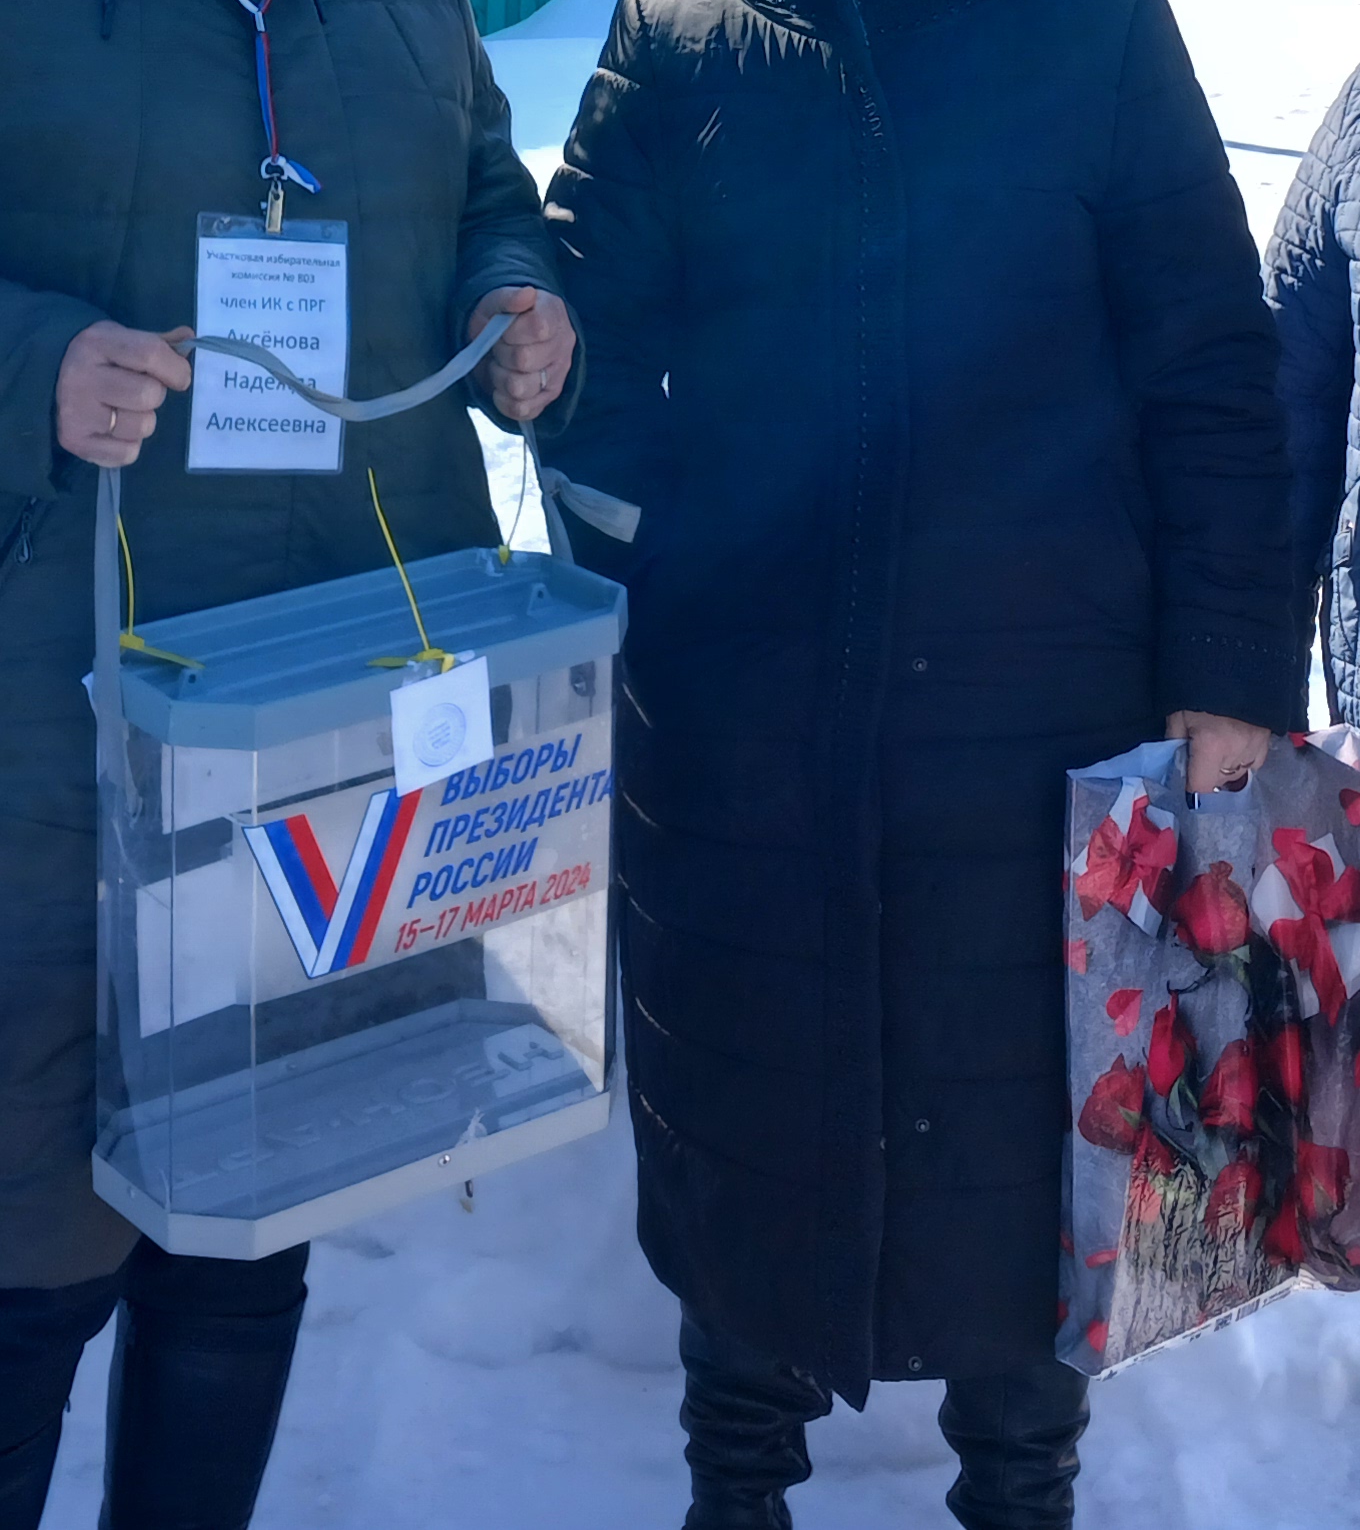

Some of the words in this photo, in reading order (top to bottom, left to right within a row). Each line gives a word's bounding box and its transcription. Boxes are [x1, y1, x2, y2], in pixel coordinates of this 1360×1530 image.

[206, 249, 264, 263] Участковая
[266, 253, 341, 268] избирательная
[231, 271, 280, 283] комиссия
[283, 272, 295, 283] №
[220, 297, 257, 310] член
[262, 296, 282, 311] ИК
[286, 300, 294, 311] с
[298, 298, 326, 313] ПРГ
[206, 411, 327, 434] Алексеевна
[440, 733, 583, 807] ВЫБОРЫ
[423, 765, 615, 858] ПРЕЗИДЕНТА
[406, 837, 539, 909] РОССИИ
[459, 885, 536, 933] МАРТА
[540, 861, 593, 907] 2024
